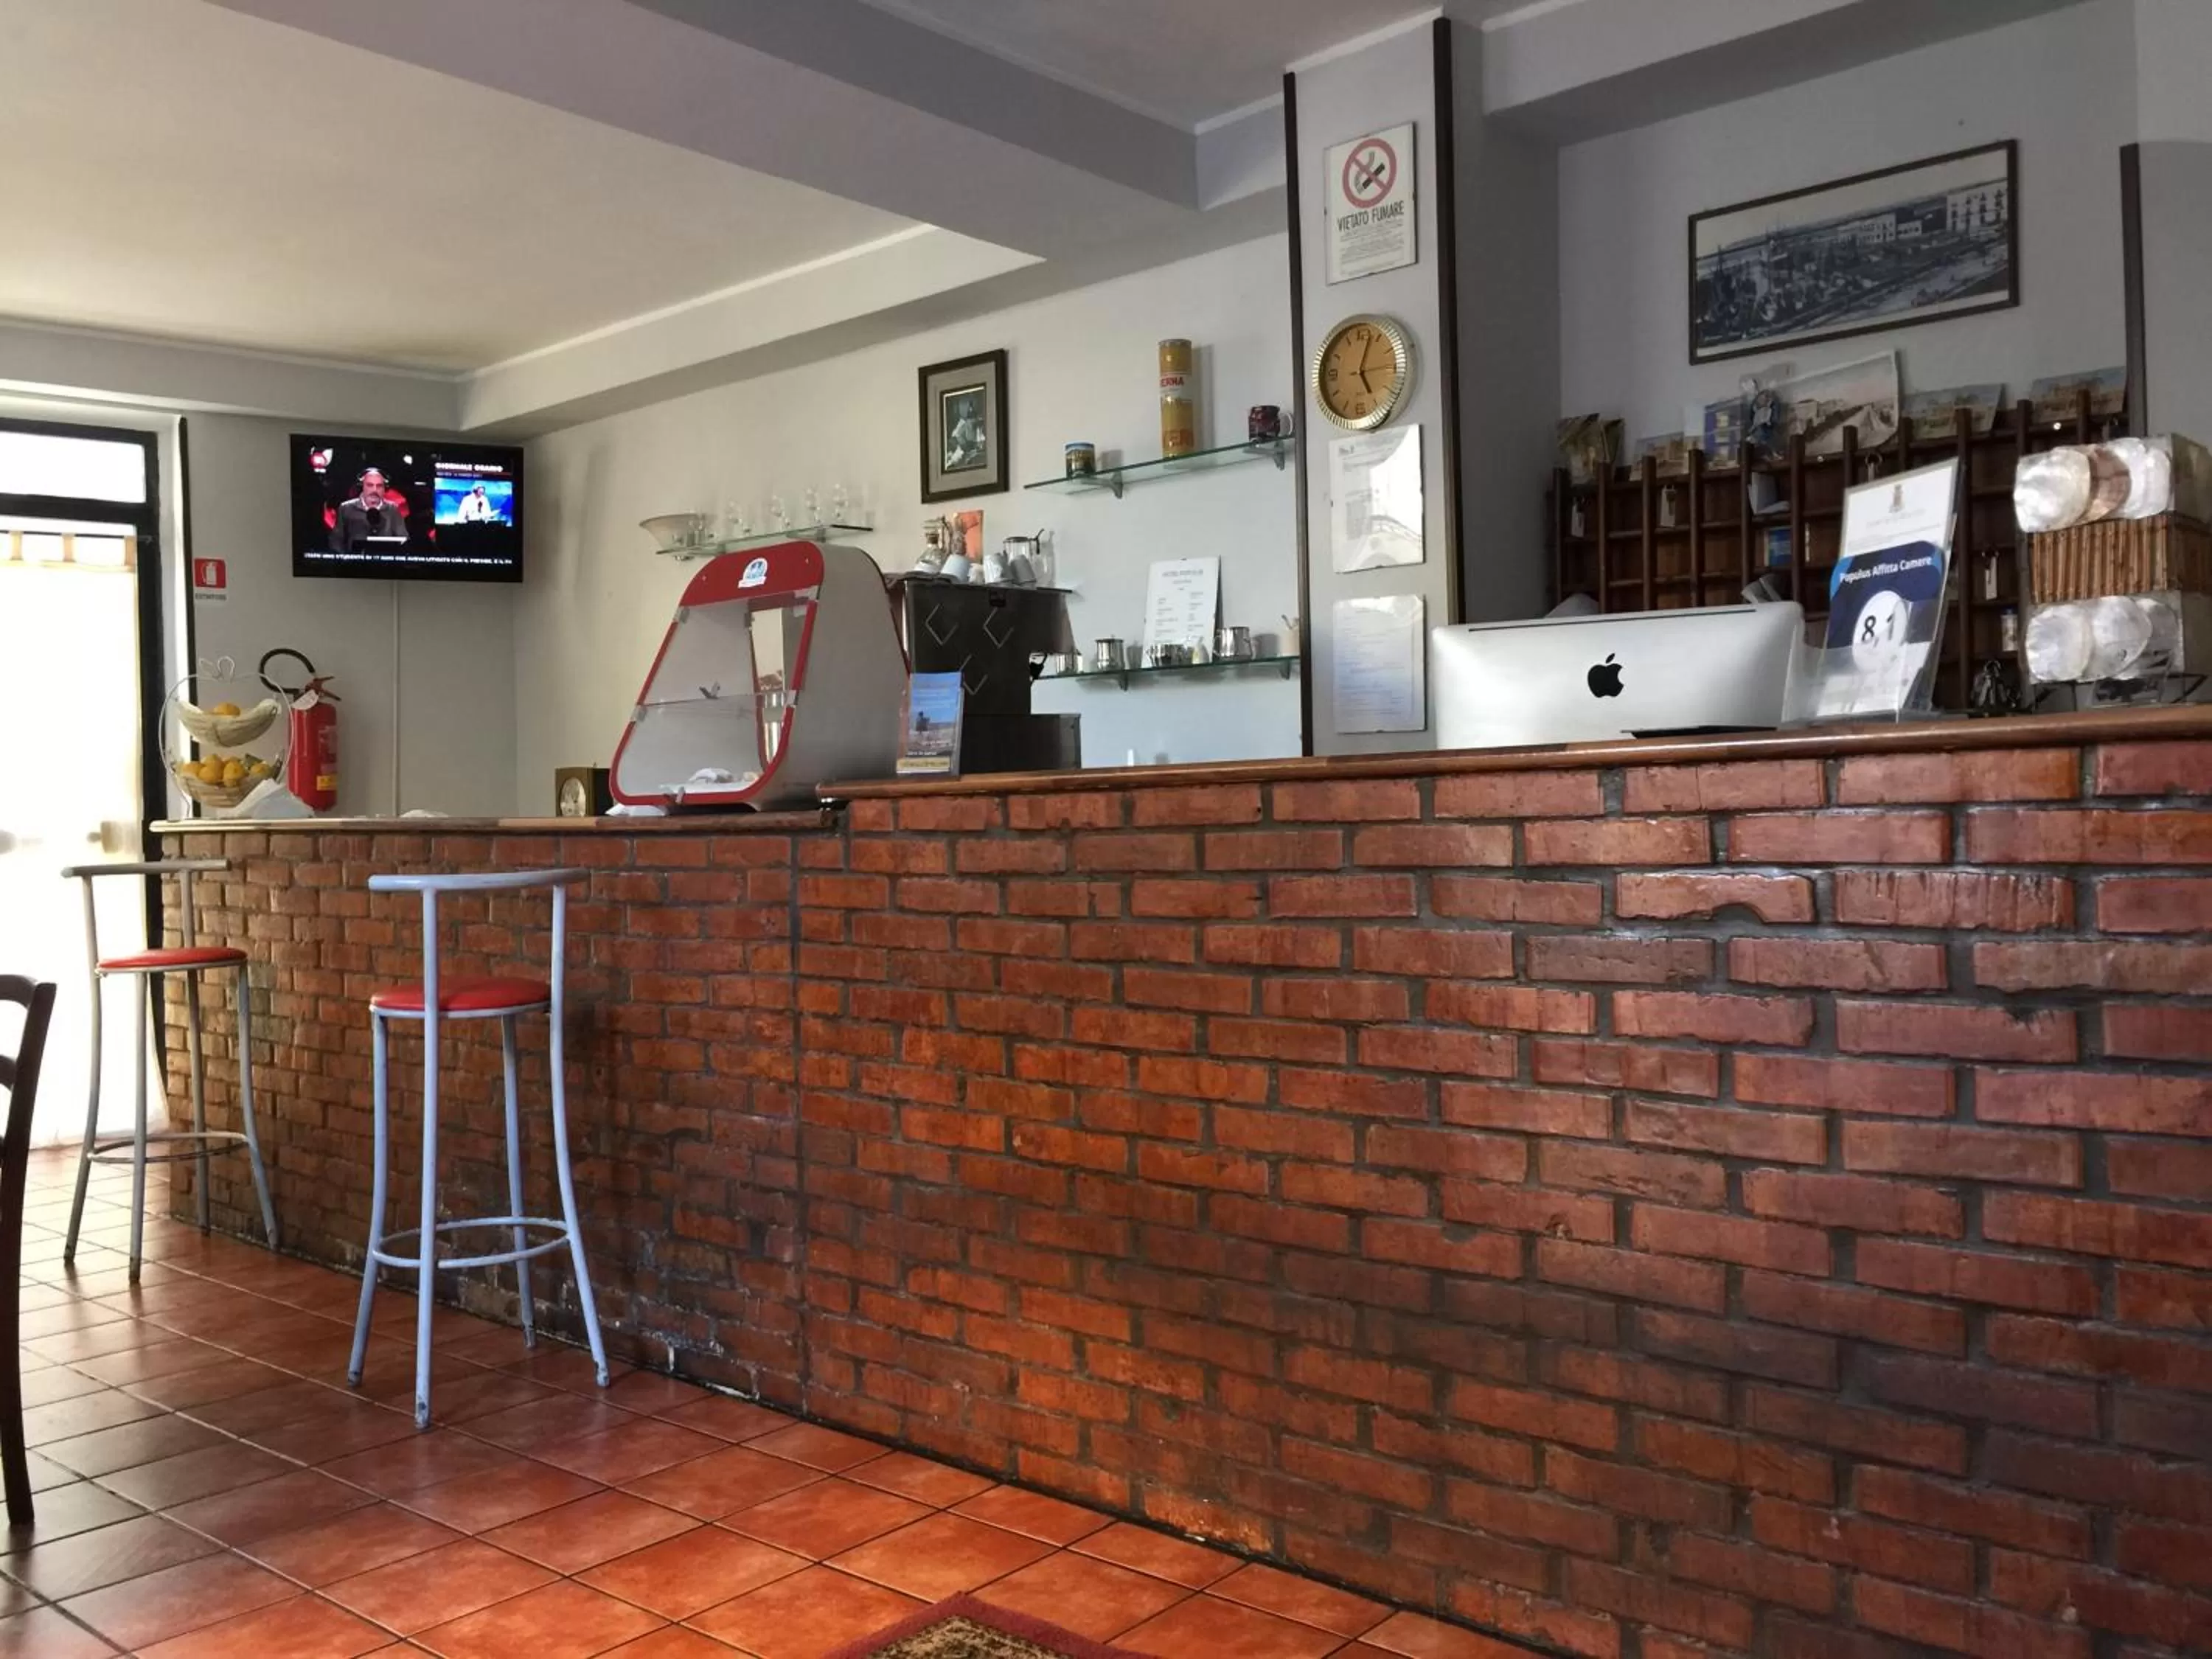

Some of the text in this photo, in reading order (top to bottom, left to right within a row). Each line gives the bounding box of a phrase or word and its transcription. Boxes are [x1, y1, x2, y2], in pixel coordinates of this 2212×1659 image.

[1337, 200, 1405, 232] VIETATO FUMARE
[1840, 556, 1932, 584] Populus Affitta Camere
